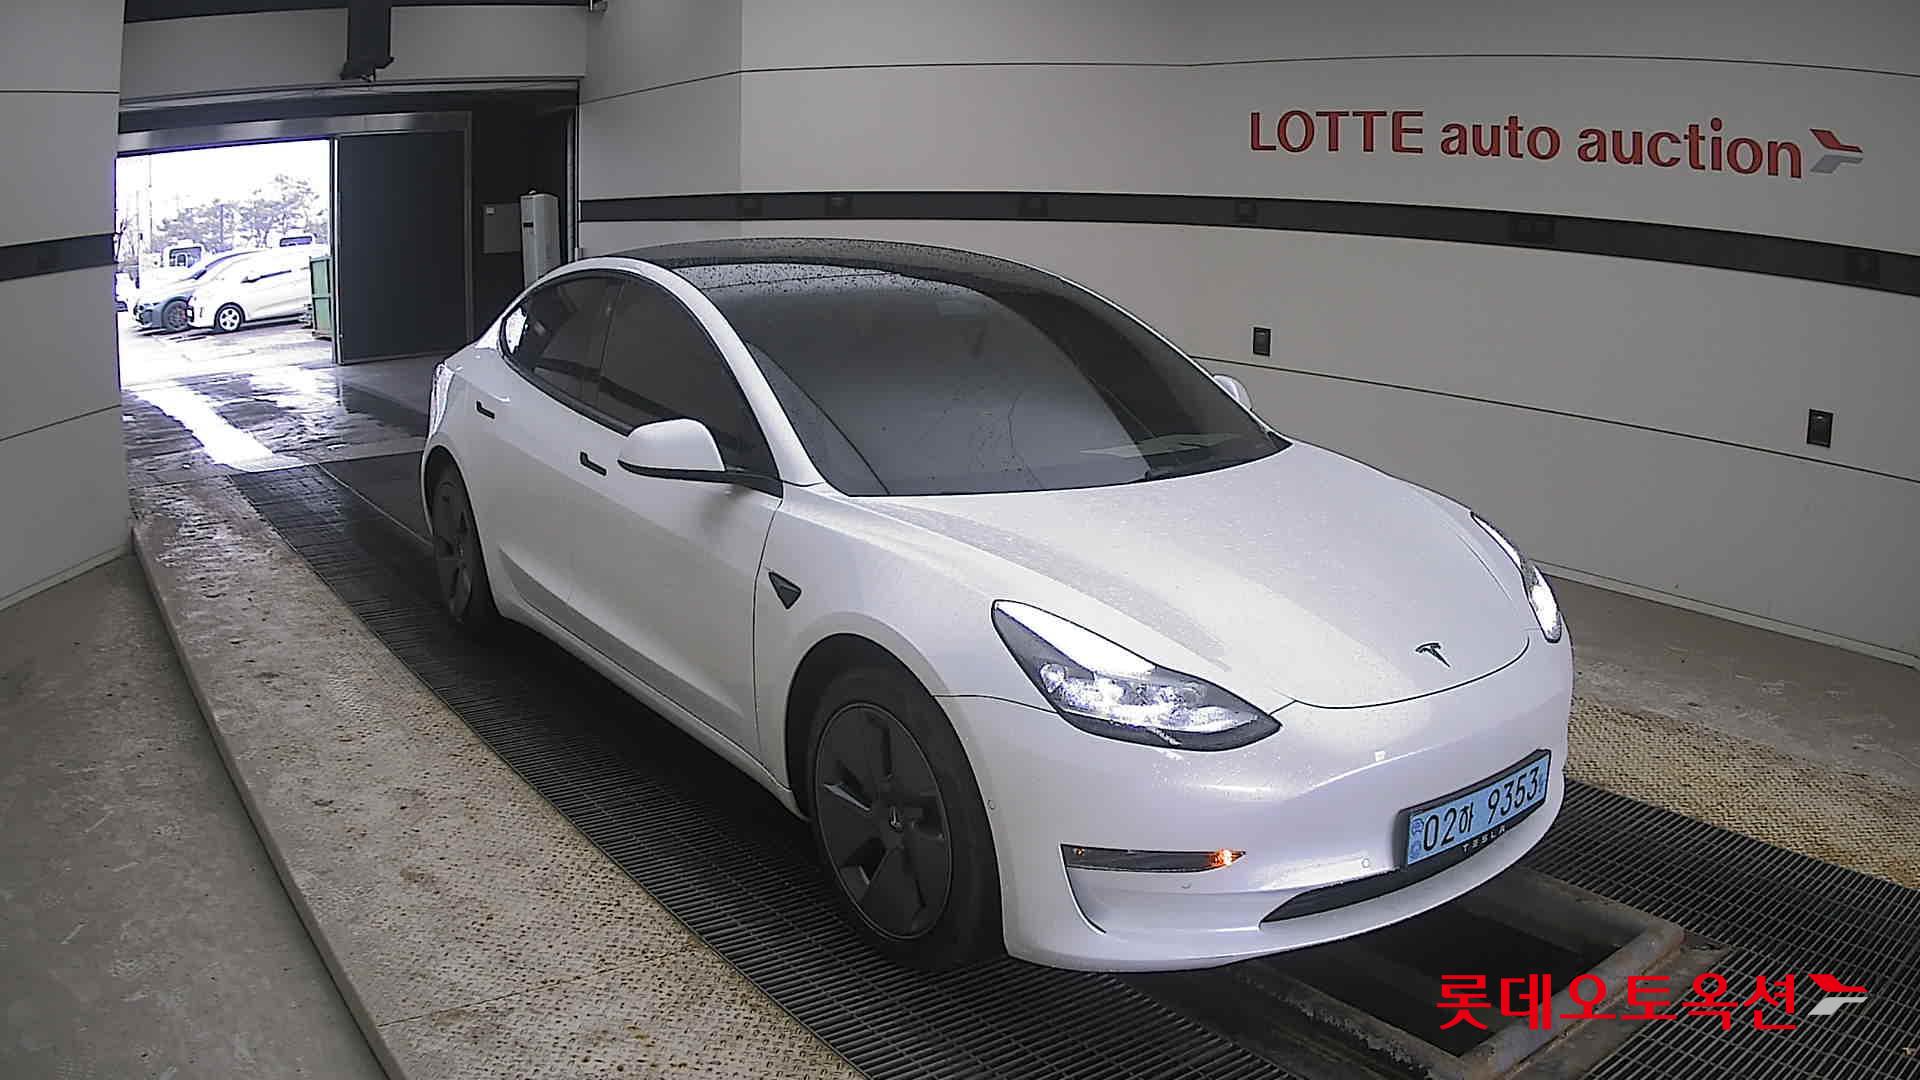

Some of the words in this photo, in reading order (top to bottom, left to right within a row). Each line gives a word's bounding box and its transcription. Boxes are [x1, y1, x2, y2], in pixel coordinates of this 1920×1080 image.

[1250, 110, 1424, 153] LOTTE
[1440, 115, 1561, 160] auto
[1577, 118, 1803, 178] auction
[1488, 766, 1540, 824] 9353
[1463, 825, 1506, 852] TESLA
